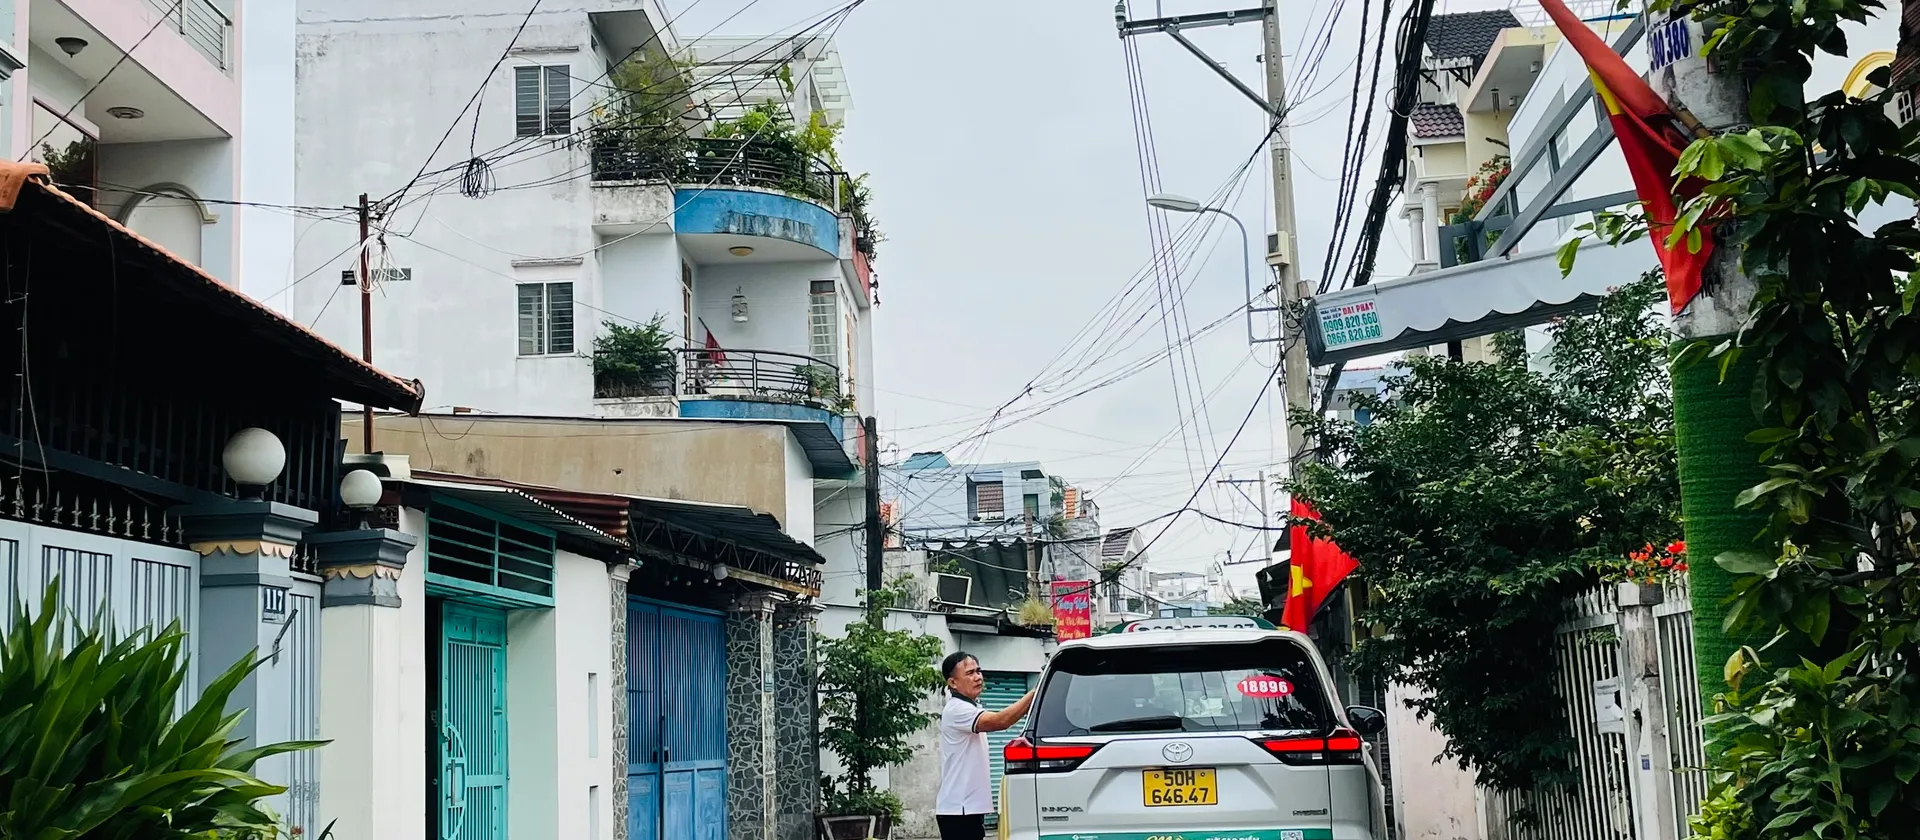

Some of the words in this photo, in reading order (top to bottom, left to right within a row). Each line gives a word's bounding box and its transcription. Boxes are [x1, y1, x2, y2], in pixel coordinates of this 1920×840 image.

[1323, 311, 1378, 333] 0909.820.660
[1327, 324, 1381, 345] 0866.820.660
[266, 588, 283, 612] 117
[1240, 680, 1288, 694] 18896
[1164, 770, 1196, 787] 50H
[1151, 787, 1209, 804] 646.47
